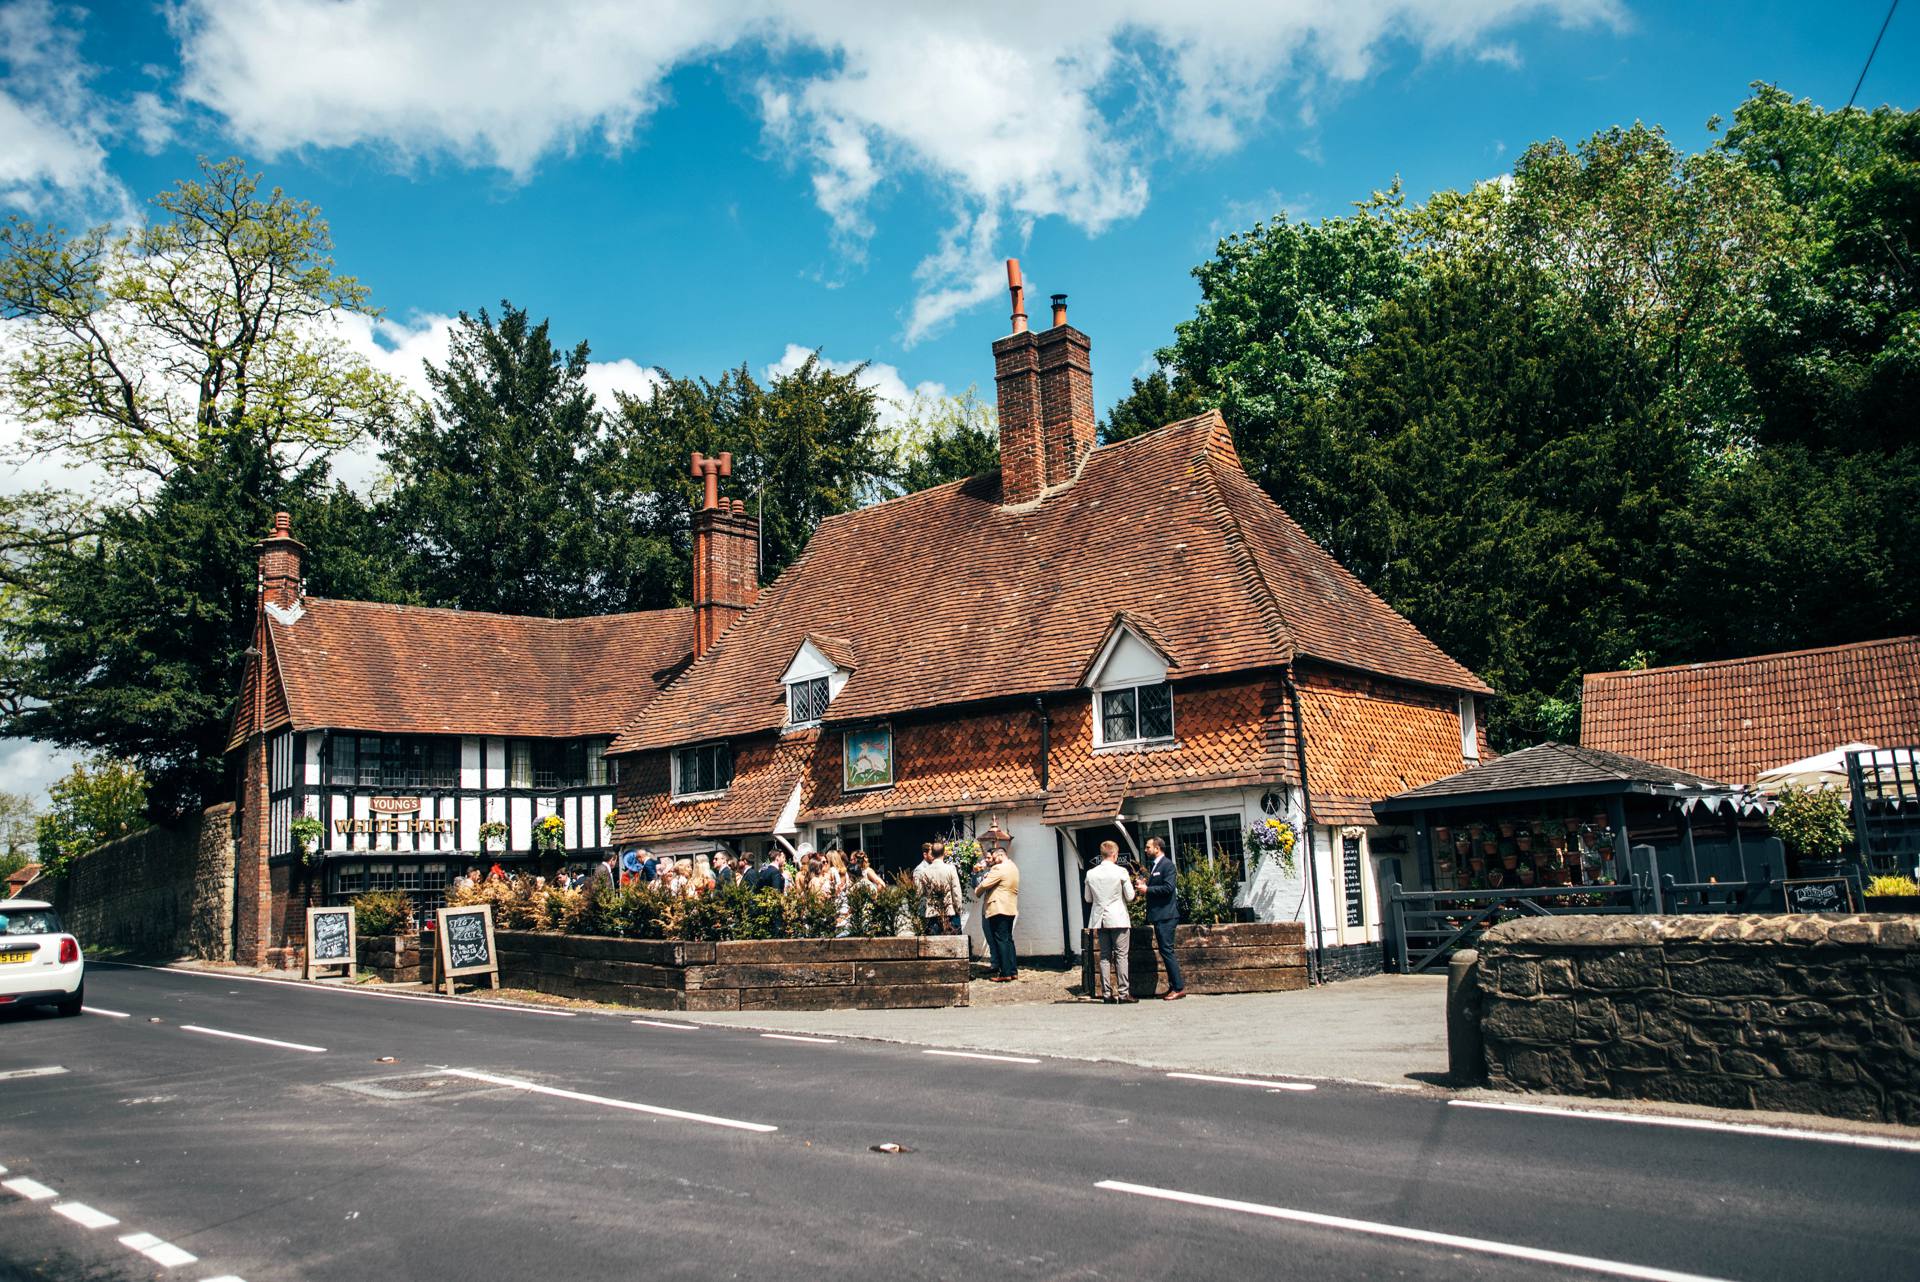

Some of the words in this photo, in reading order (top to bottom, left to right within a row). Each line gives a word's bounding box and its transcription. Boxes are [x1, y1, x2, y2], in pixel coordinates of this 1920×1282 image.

[373, 799, 418, 810] YOUNG'S
[335, 818, 399, 833] WHITE
[407, 818, 457, 833] HART
[9, 952, 28, 961] EPF
